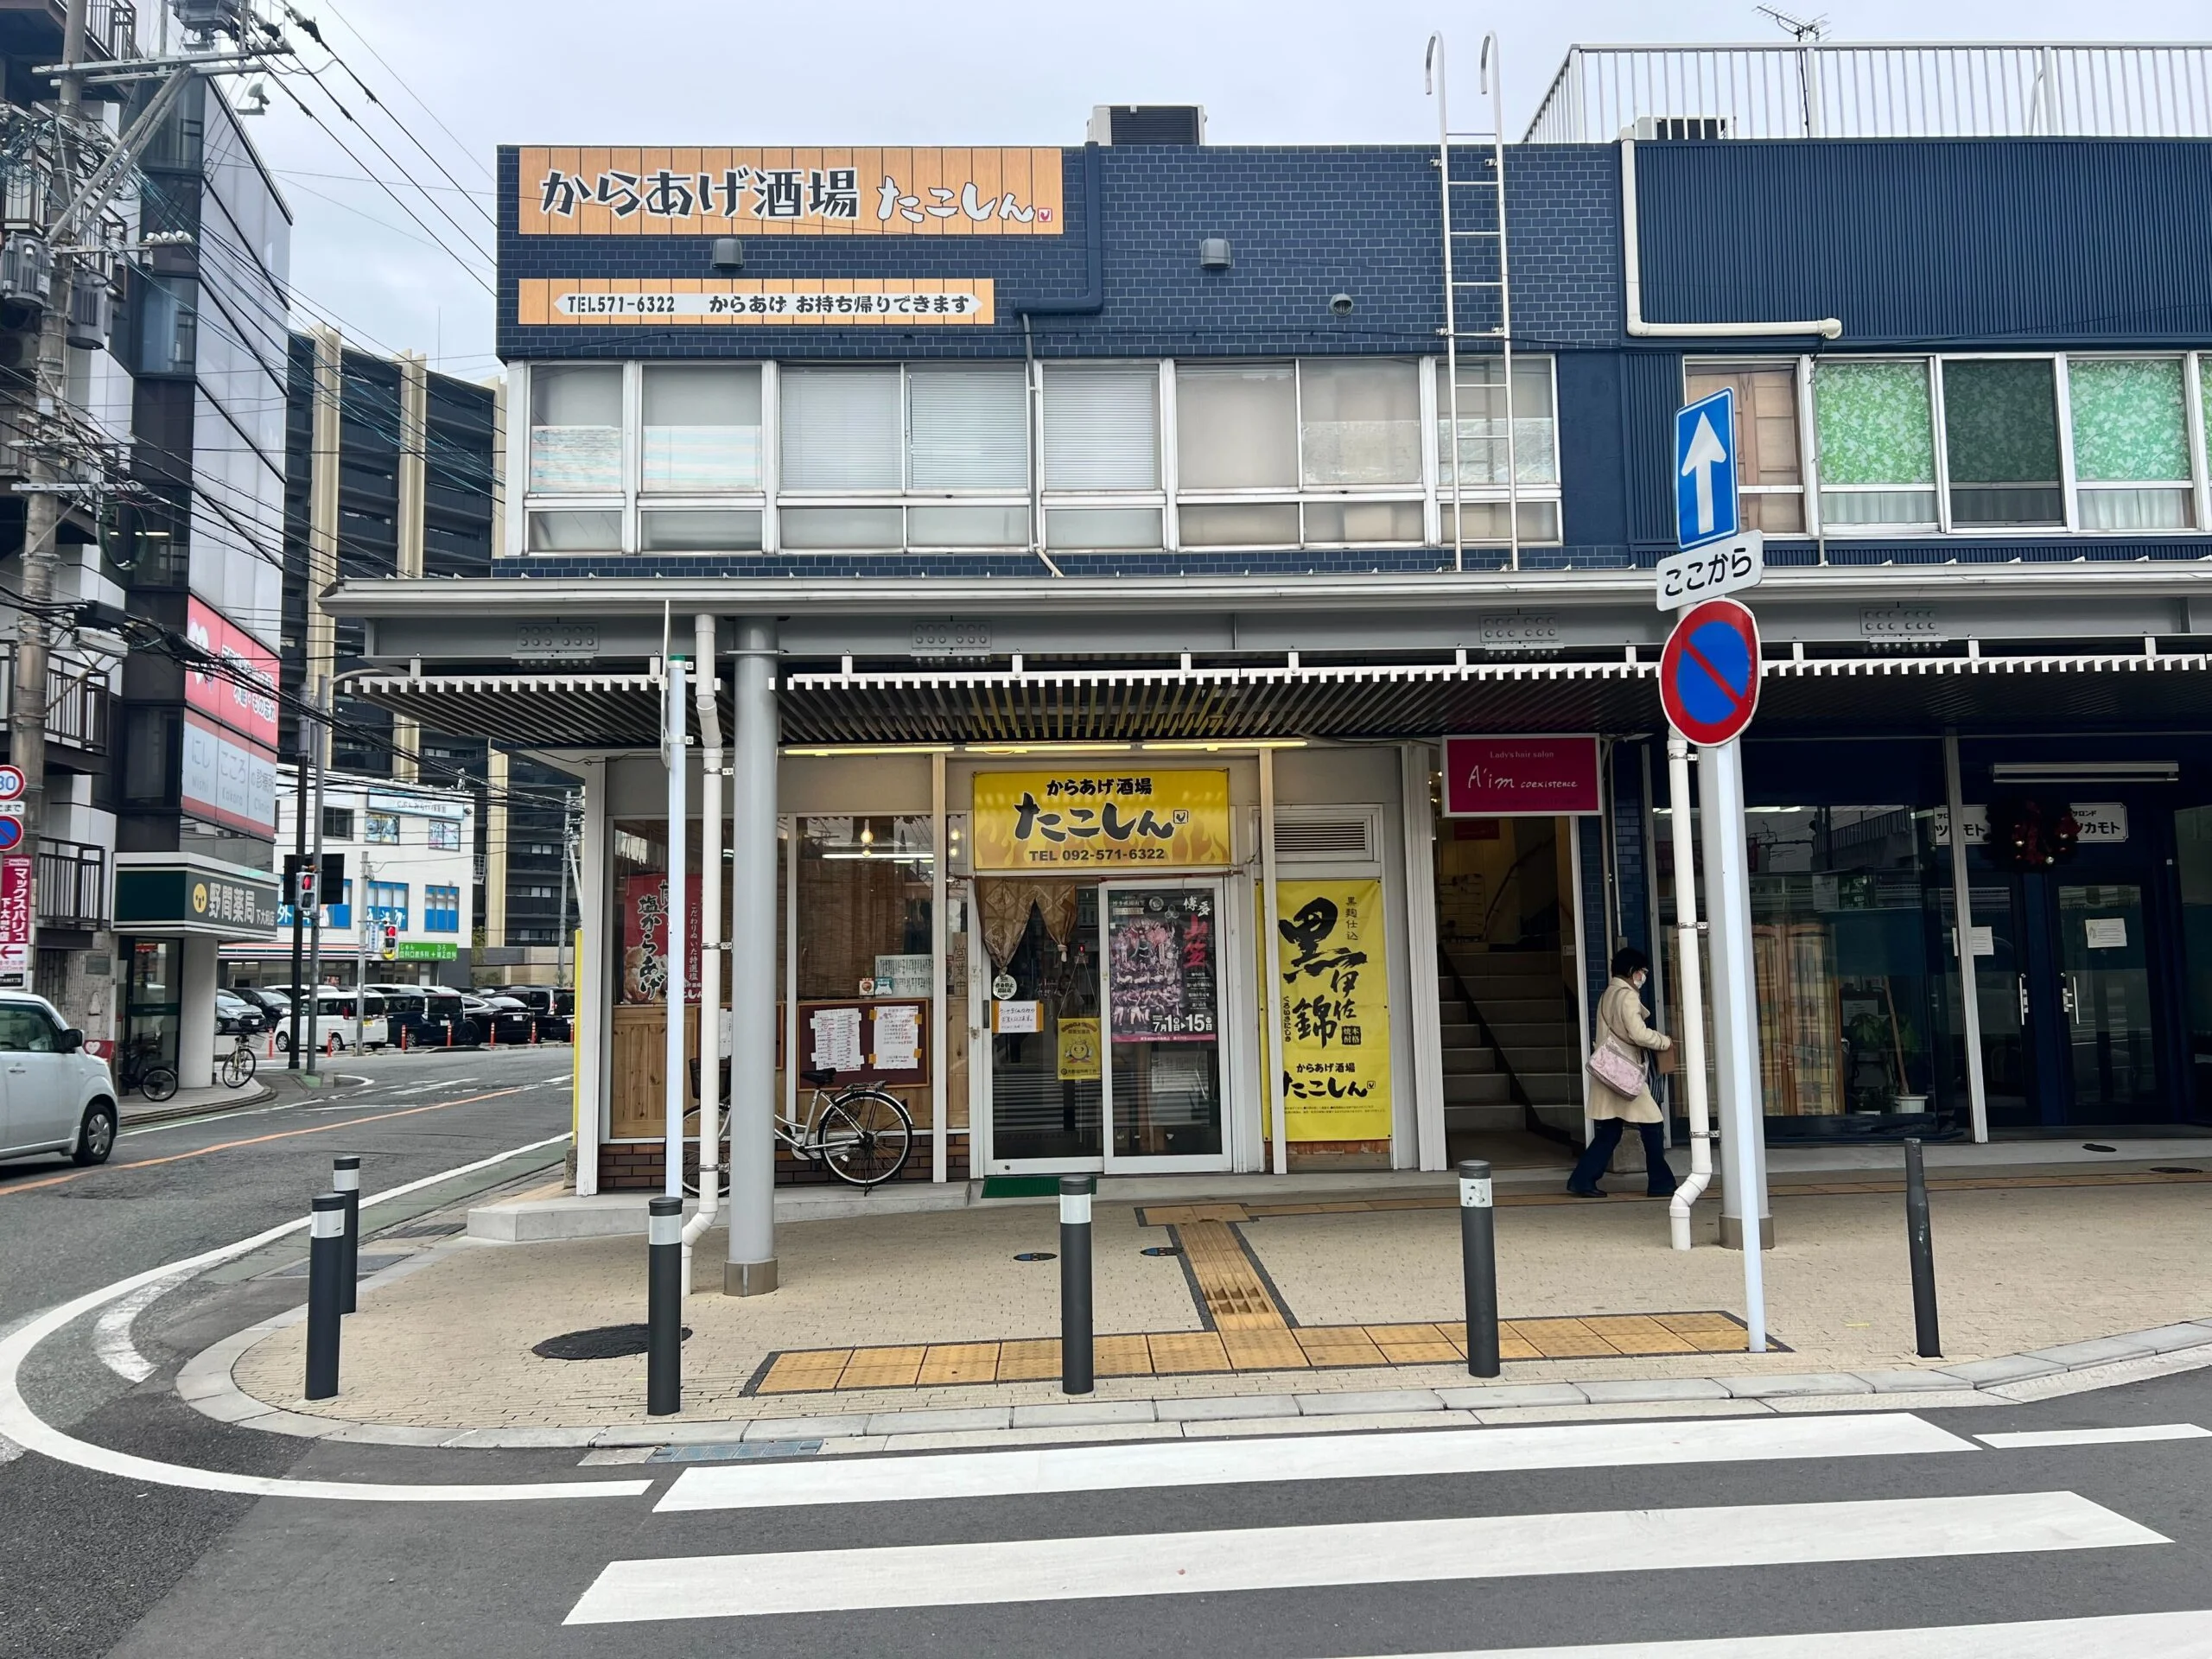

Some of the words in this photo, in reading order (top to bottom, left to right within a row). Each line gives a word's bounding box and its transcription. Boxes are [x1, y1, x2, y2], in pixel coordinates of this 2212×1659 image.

[540, 164, 860, 221] からあげ酒場
[876, 175, 1036, 223] たこしん
[709, 296, 787, 313] からあげ
[796, 295, 969, 314] お持ち帰りできます
[1664, 546, 1752, 597] ここから
[1516, 750, 1531, 759] hair
[1533, 750, 1554, 759] salon
[1046, 777, 1153, 797] からあげ酒場
[1468, 765, 1515, 790] A'im
[1520, 780, 1579, 789] coexistence
[1014, 791, 1175, 843] たこしん
[1935, 823, 1986, 836] ツモト
[1028, 849, 1058, 861] TEL
[1062, 848, 1165, 861] 092-571-6322
[12, 868, 29, 942] マックスバリュ
[208, 882, 255, 925] 野間薬局
[1183, 895, 1211, 918] 博多
[1345, 896, 1358, 941] 黒麹仕込
[637, 893, 665, 1000] 塩からあげ
[1296, 1062, 1355, 1073] からあげ酒場
[1283, 1071, 1368, 1099] たこしん
